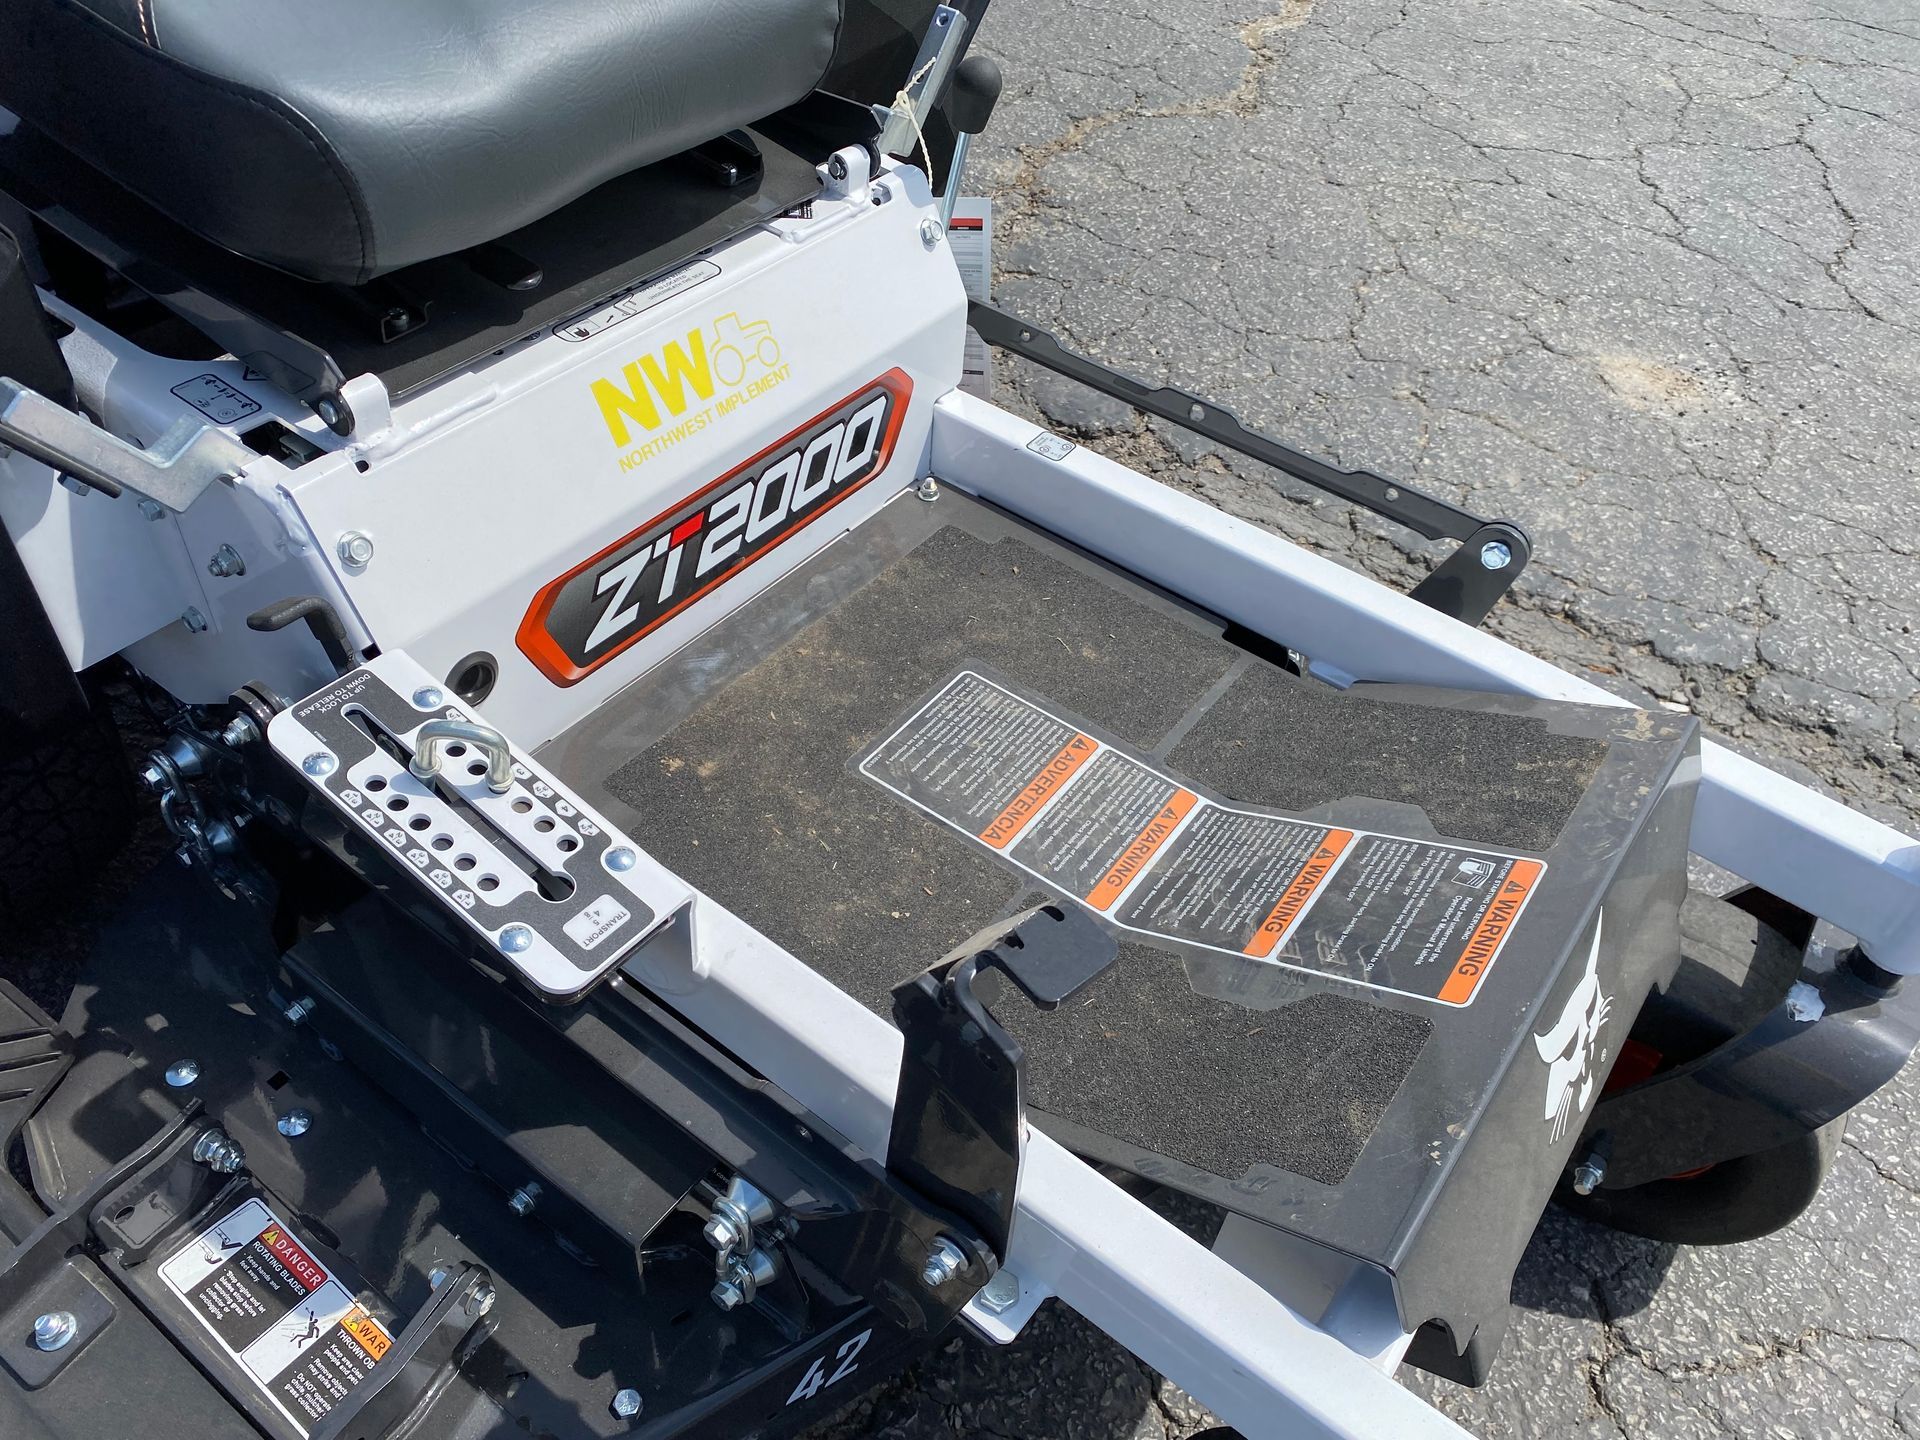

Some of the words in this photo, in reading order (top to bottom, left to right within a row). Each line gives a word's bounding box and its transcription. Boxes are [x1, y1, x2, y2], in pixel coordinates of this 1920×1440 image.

[589, 327, 715, 449] NW
[618, 408, 713, 474] NORTHWEST
[716, 363, 792, 418] IMPLEMENT
[333, 686, 347, 696] TO
[340, 690, 354, 700] TO
[345, 672, 371, 689] DOWN
[351, 683, 365, 693] UP
[297, 693, 335, 717] RELEASE
[317, 697, 342, 713] LOCK
[984, 750, 1077, 843] ADVERTENCIA
[1105, 821, 1168, 888] WARNING
[1495, 859, 1512, 879] BEFORE
[1262, 862, 1326, 934] WARNING
[1458, 896, 1473, 910] Read
[1481, 879, 1501, 903] STARTING
[1439, 895, 1462, 922] Operator's
[1452, 911, 1464, 921] and
[1476, 904, 1486, 912] OR
[580, 910, 627, 947] TRANSPORT
[1427, 922, 1445, 942] Manual
[1433, 921, 1458, 952] understand
[1456, 898, 1517, 977] WARNING
[1427, 952, 1439, 962] the
[238, 1260, 250, 1271] feet
[245, 1255, 259, 1268] Keep
[256, 1266, 272, 1281] hands
[268, 1279, 280, 1290] and
[252, 1240, 283, 1272] ROTATING
[279, 1269, 305, 1296] BLADES
[274, 1239, 322, 1286] DANGER
[197, 1292, 225, 1321] unclogging.
[204, 1287, 226, 1308] collector
[222, 1305, 231, 1313] or
[211, 1282, 233, 1304] removing
[230, 1301, 245, 1316] grass
[217, 1276, 235, 1293] blades
[231, 1290, 245, 1303] stop
[241, 1300, 258, 1317] before
[224, 1270, 238, 1283] Stop
[235, 1281, 252, 1298] engine
[249, 1296, 260, 1307] and
[257, 1304, 266, 1313] let
[335, 1328, 365, 1359] THROWN
[312, 1357, 333, 1379] Remove
[322, 1348, 341, 1367] people
[337, 1363, 350, 1376] and
[329, 1343, 344, 1358] Keep
[340, 1355, 354, 1368] area
[350, 1366, 364, 1380] clear
[786, 1328, 872, 1406] 42
[289, 1377, 307, 1395] chute,
[303, 1392, 324, 1413] mulcher
[296, 1372, 306, 1382] Do
[302, 1379, 316, 1394] NOT
[312, 1390, 332, 1412] operate
[306, 1362, 320, 1376] may
[316, 1373, 332, 1389] strike
[329, 1386, 341, 1398] and
[283, 1382, 300, 1398] grass
[296, 1396, 319, 1419] collector
